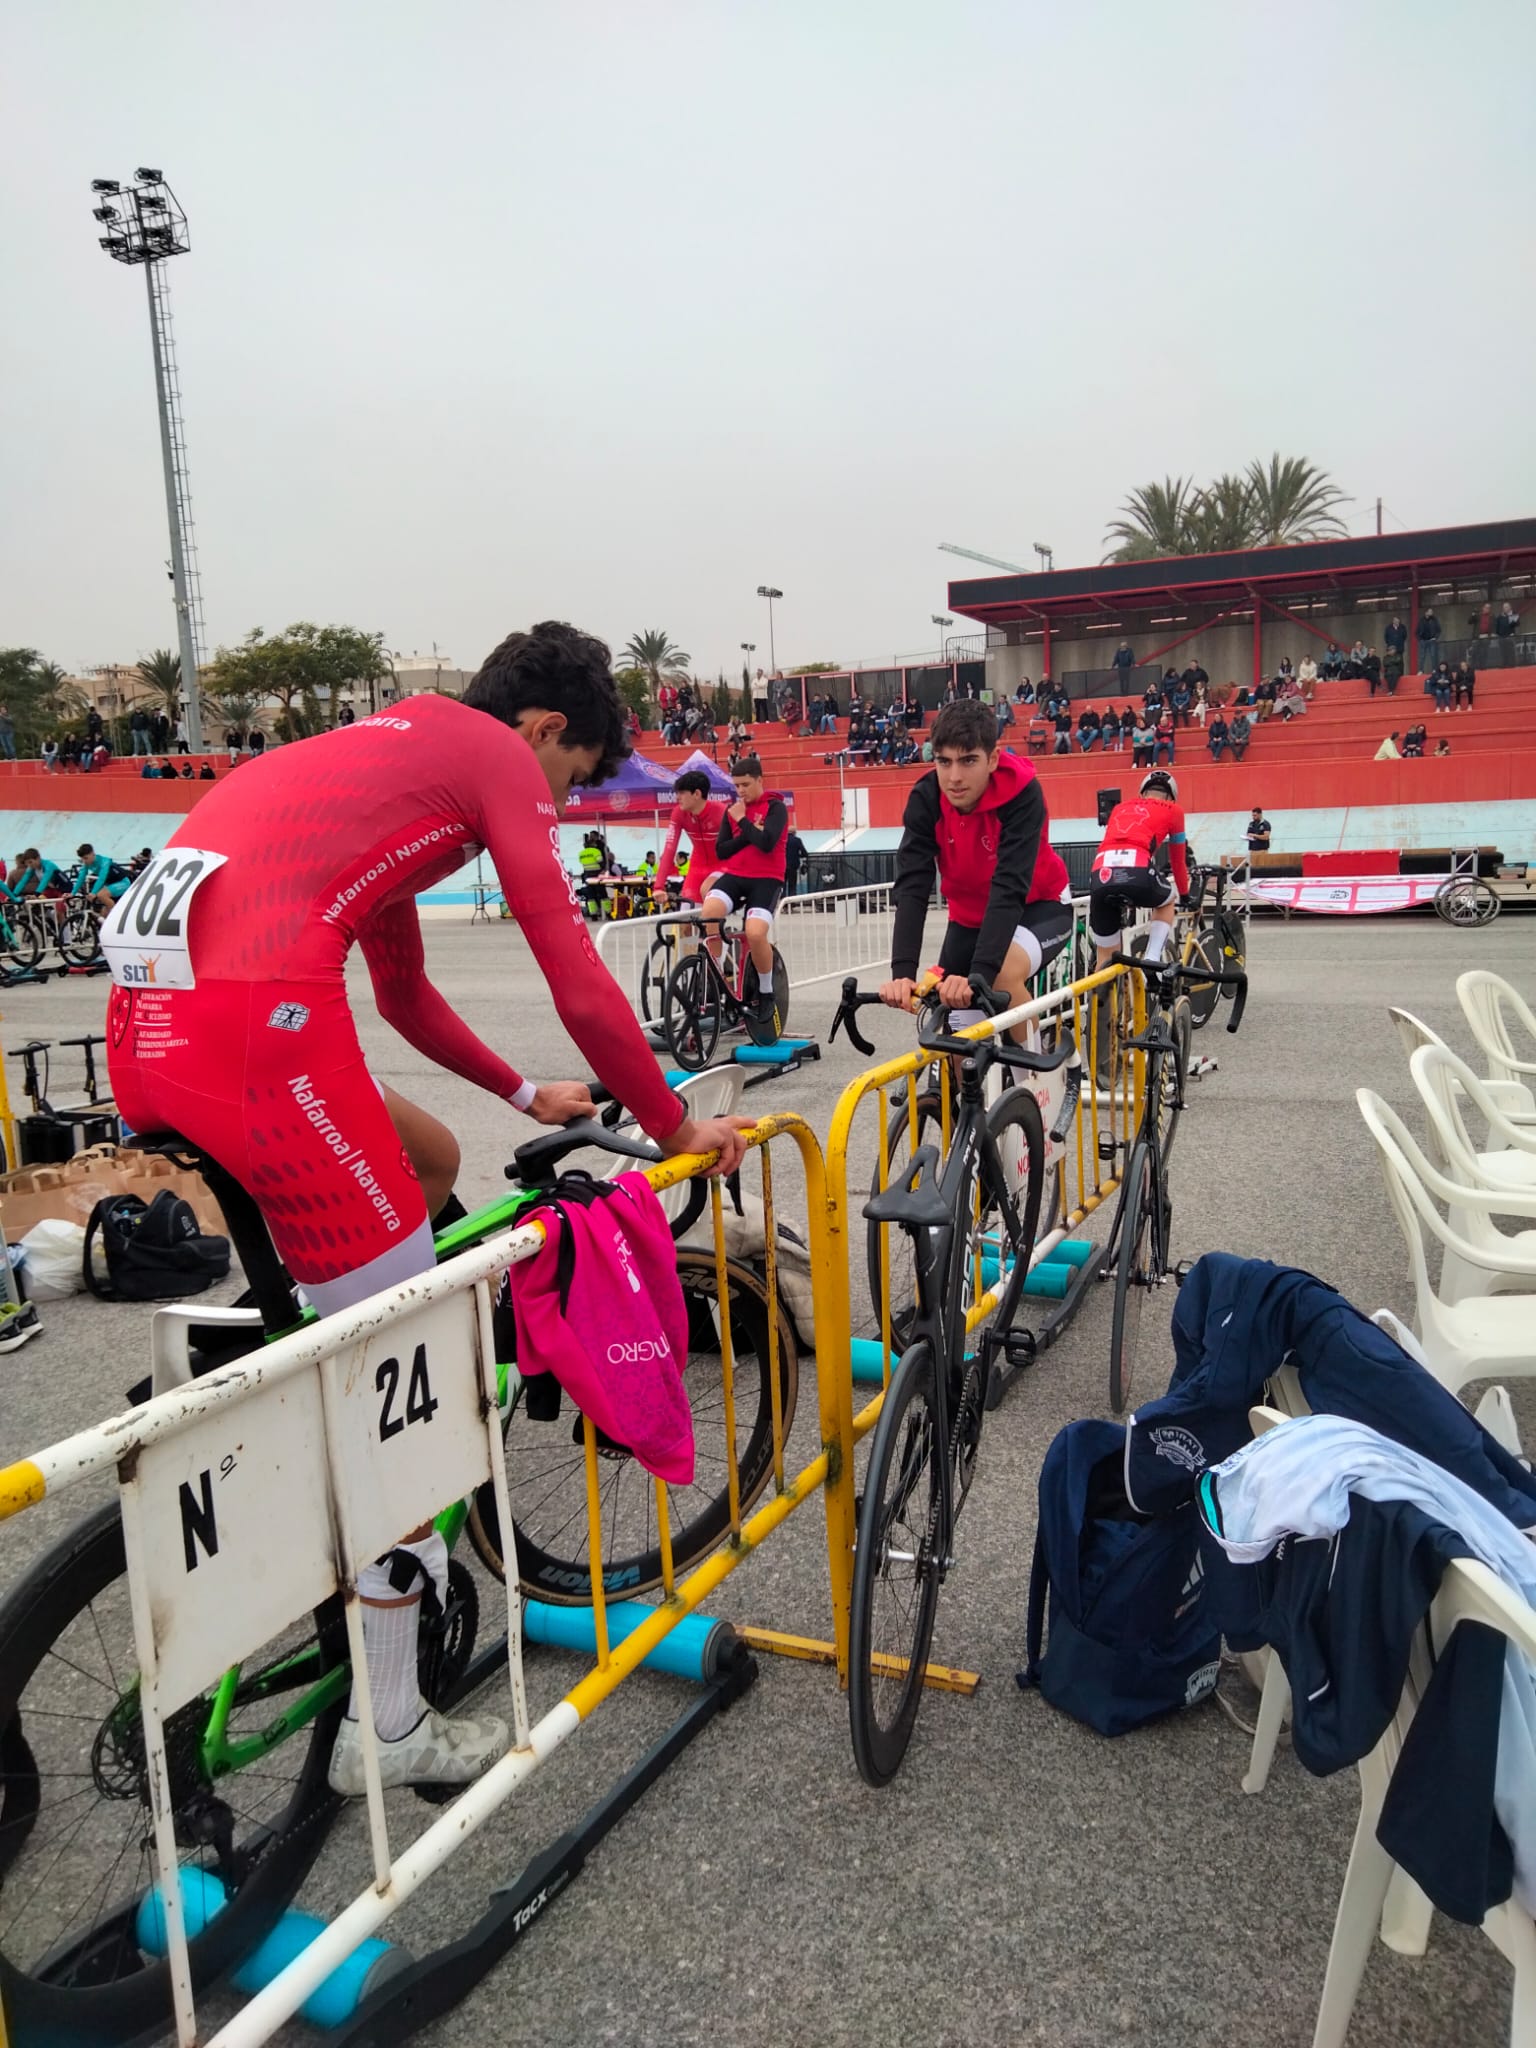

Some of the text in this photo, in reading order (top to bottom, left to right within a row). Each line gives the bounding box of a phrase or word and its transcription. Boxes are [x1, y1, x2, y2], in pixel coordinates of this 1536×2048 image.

[117, 858, 204, 937] 162
[322, 861, 388, 924] Nafarroa
[395, 823, 465, 862] Navarra
[288, 1074, 351, 1156] Nafarroa
[348, 1159, 401, 1232] Navarra
[376, 1343, 438, 1442] 24
[538, 1565, 641, 1594] Viion
[512, 1888, 548, 1933] Tacx
